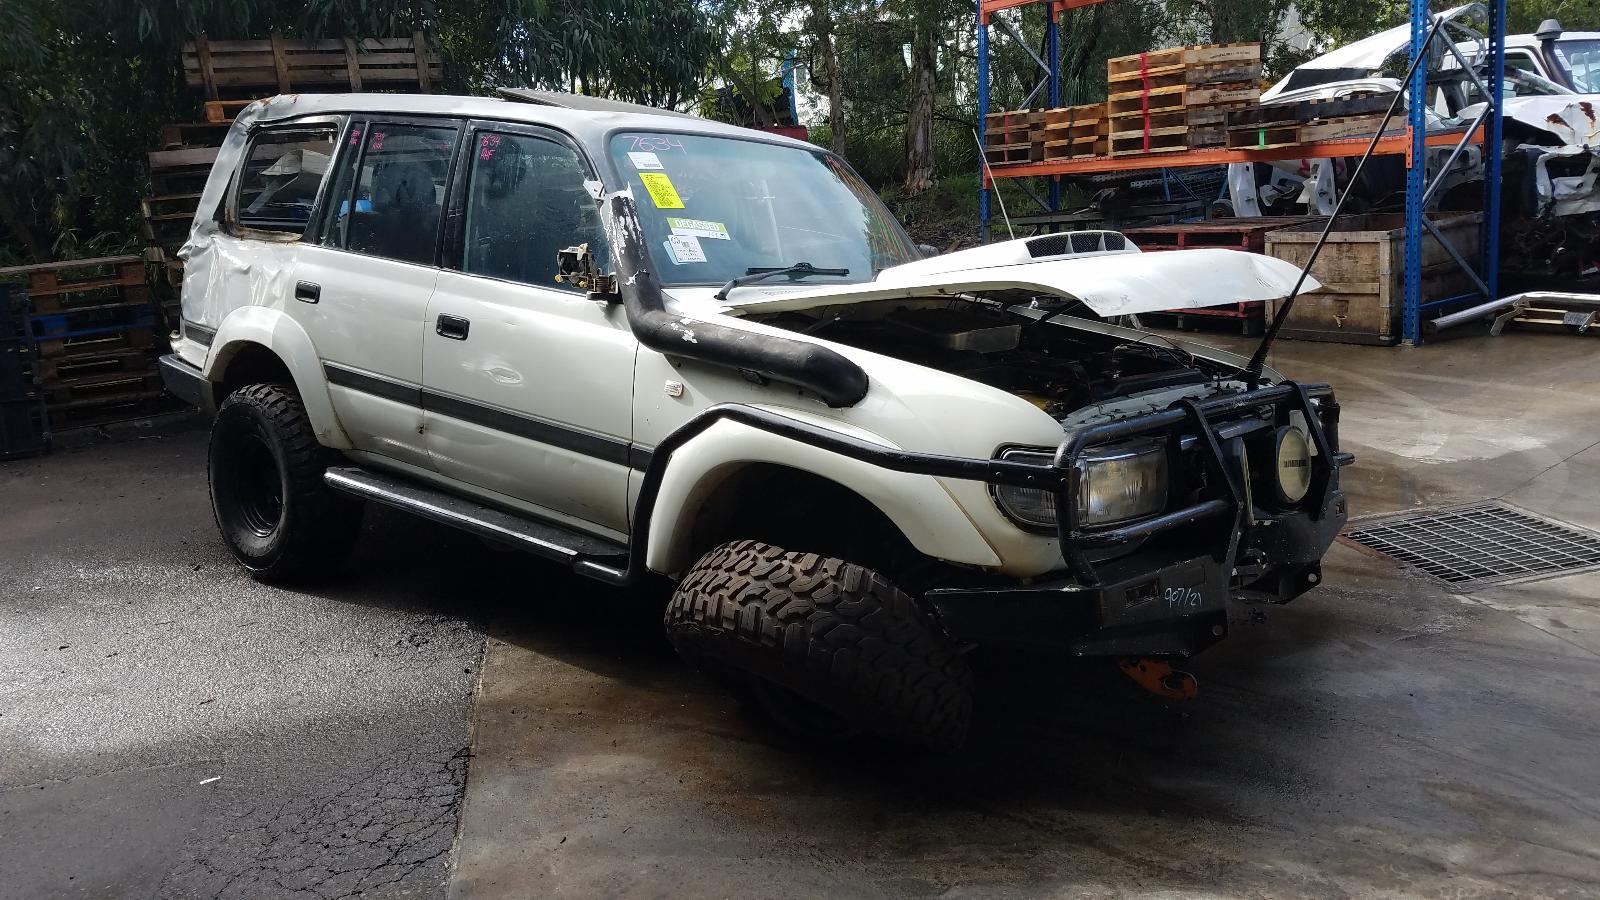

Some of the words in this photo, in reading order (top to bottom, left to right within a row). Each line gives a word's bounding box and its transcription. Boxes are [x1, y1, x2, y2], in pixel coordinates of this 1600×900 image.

[622, 136, 687, 154] 7634
[675, 219, 720, 231] DEGASSED
[1165, 588, 1202, 608] 907/21
